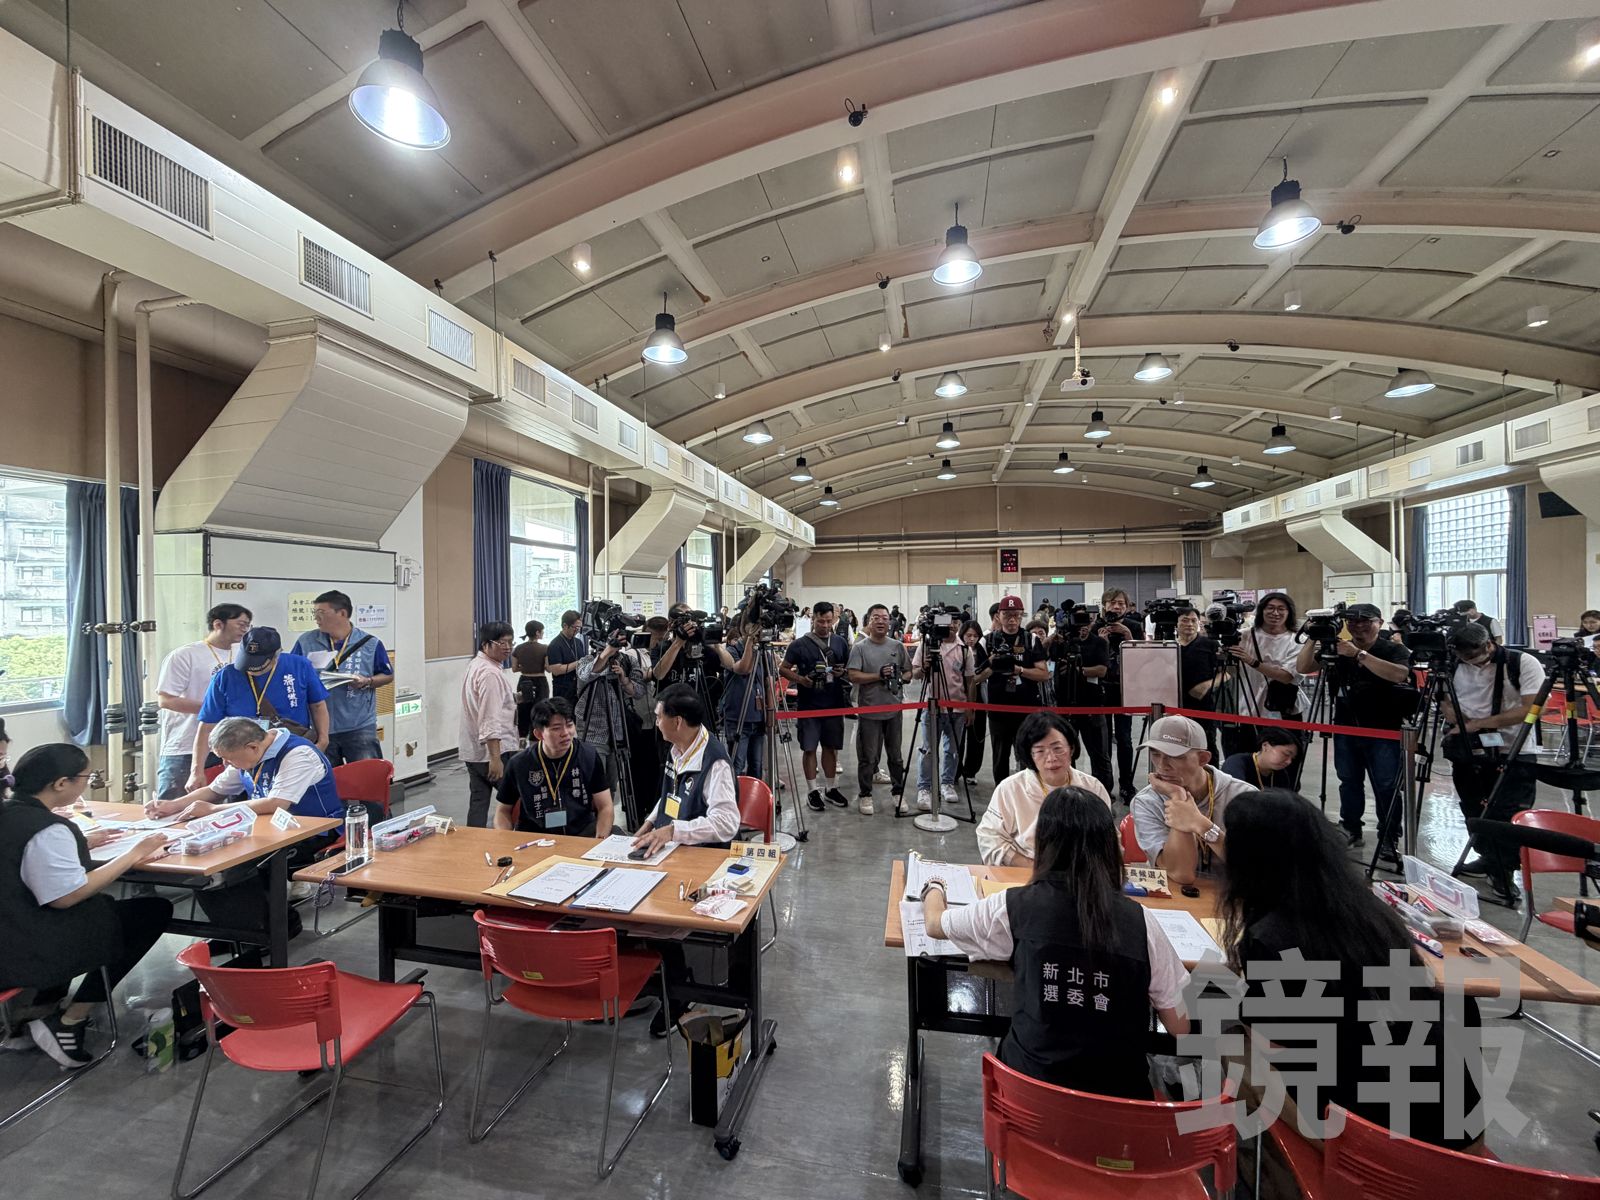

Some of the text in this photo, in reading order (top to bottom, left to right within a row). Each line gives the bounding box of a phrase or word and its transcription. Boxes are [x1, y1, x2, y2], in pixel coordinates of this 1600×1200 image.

[217, 582, 245, 590] TECO
[1008, 599, 1015, 607] R
[746, 847, 776, 859] 第四組
[1043, 962, 1110, 989] 新北市
[1043, 984, 1111, 1012] 選委會
